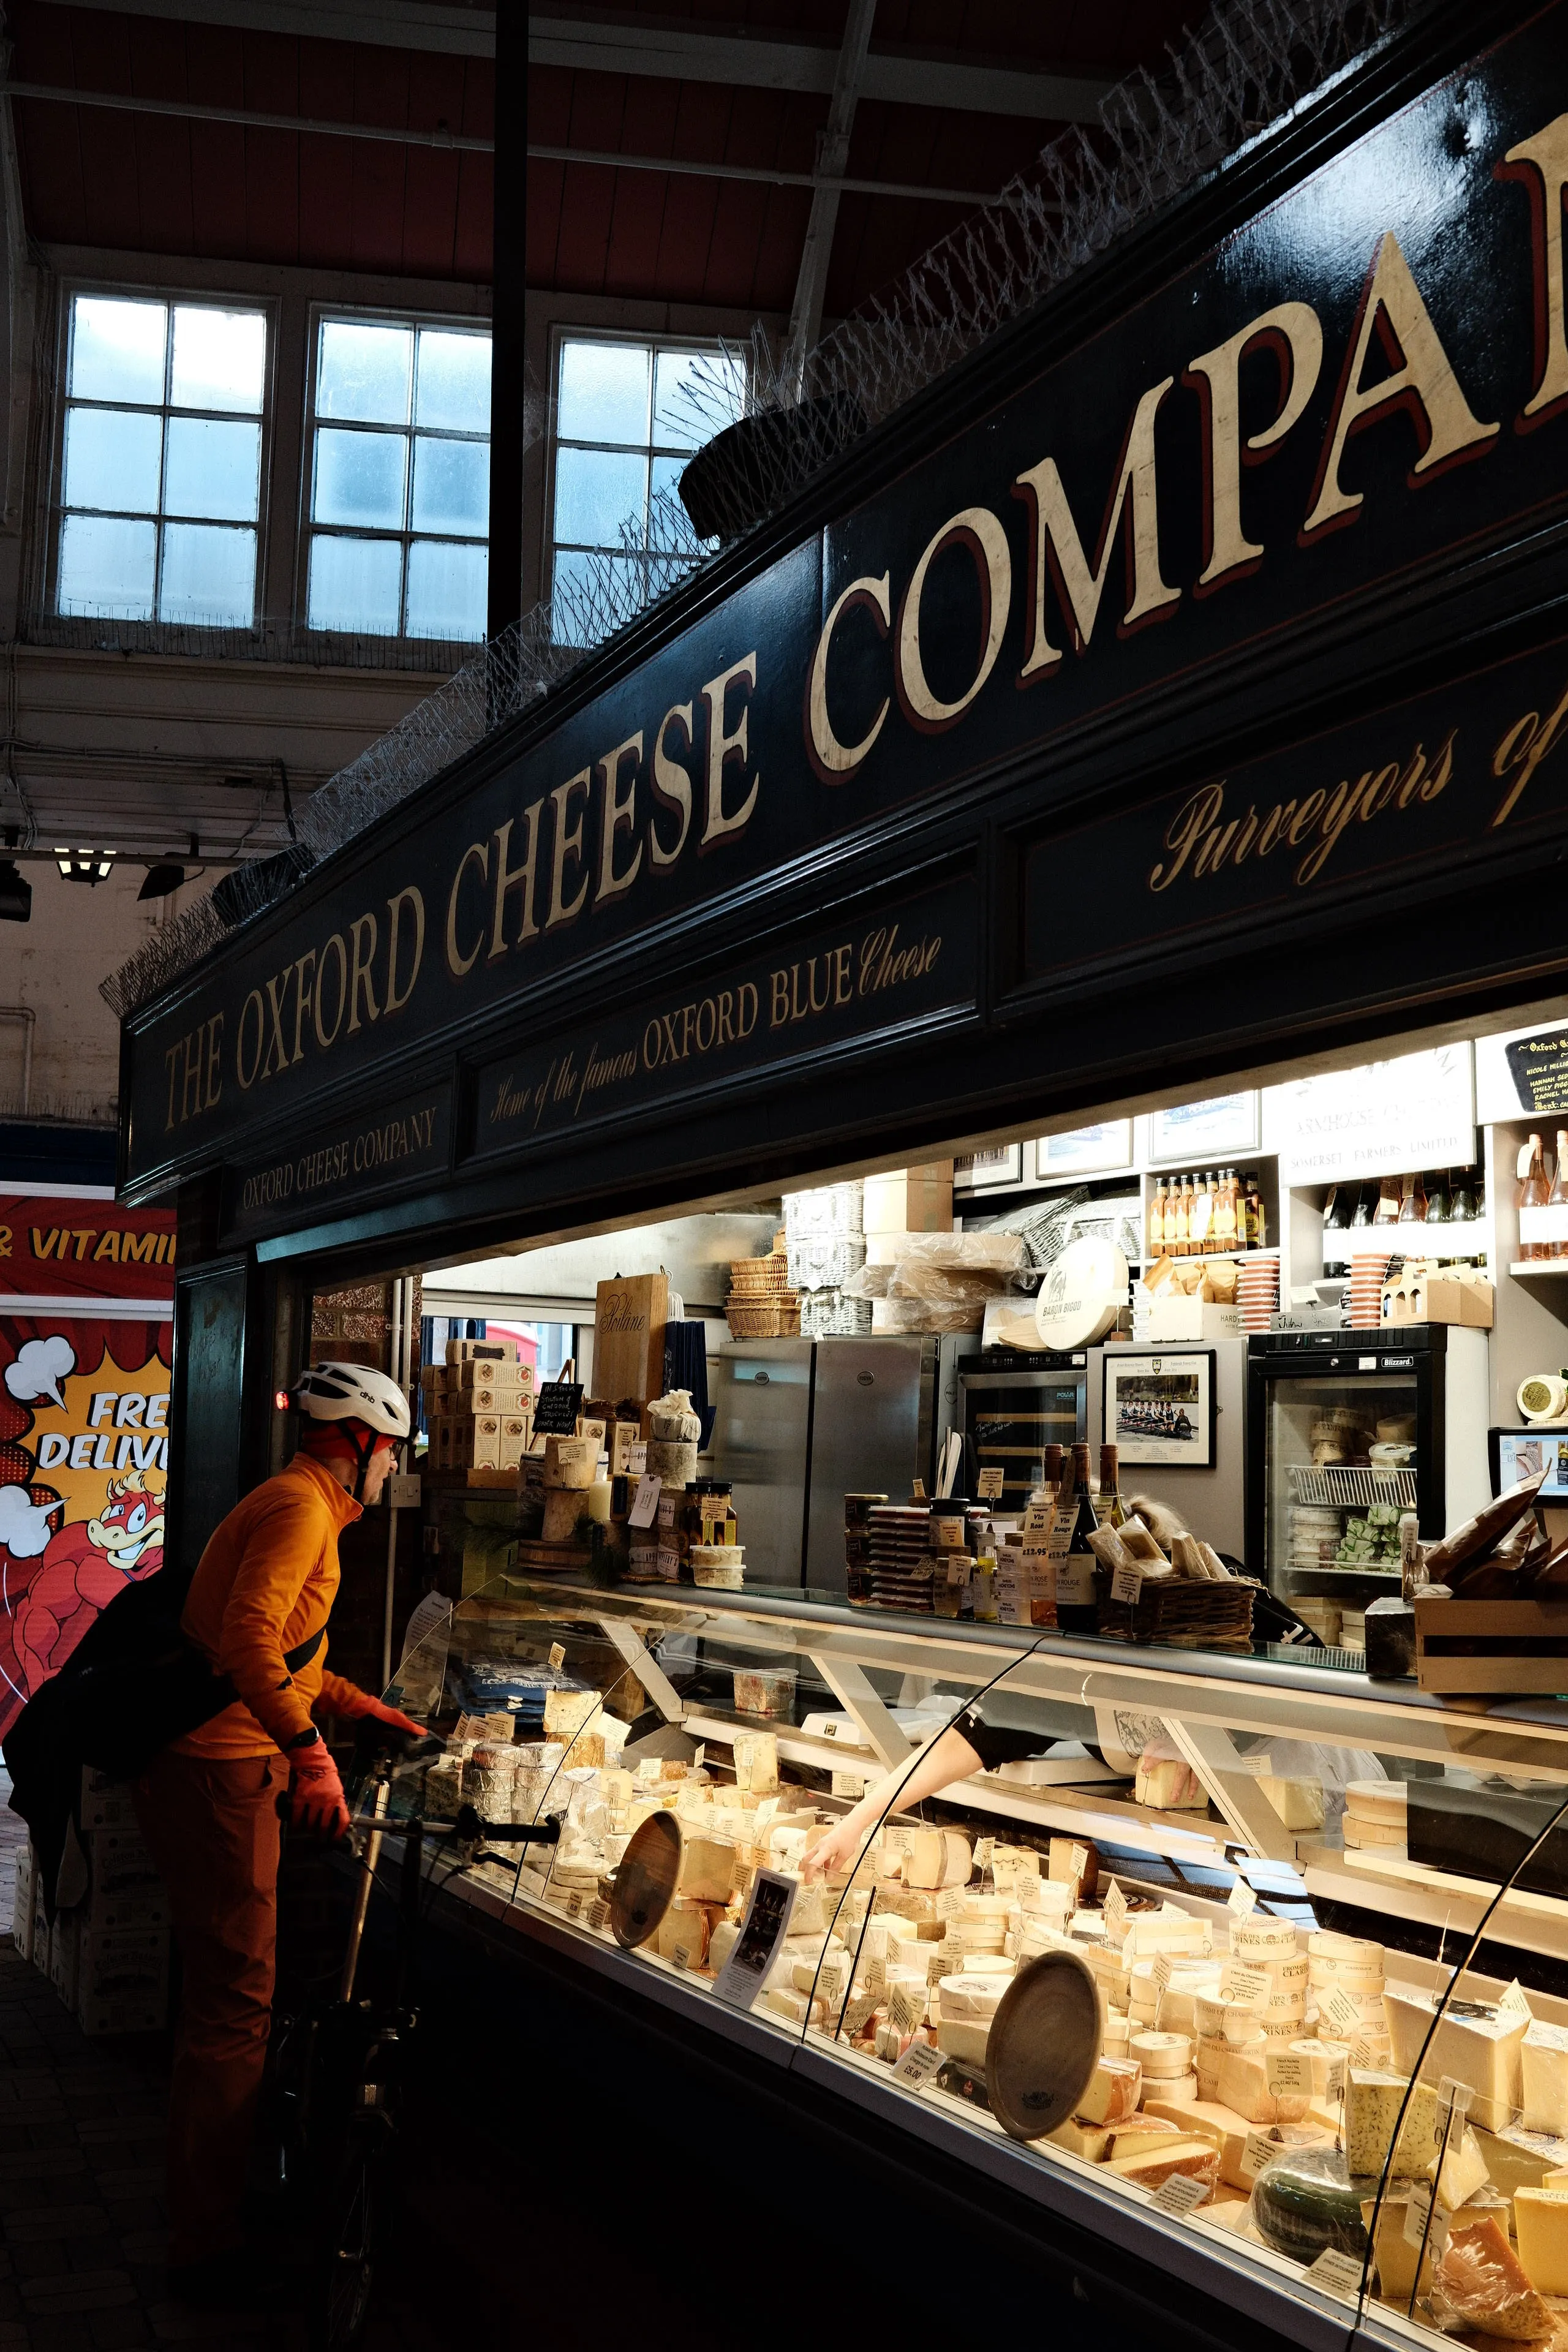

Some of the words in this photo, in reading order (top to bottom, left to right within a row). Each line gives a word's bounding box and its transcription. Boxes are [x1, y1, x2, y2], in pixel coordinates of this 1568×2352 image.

[1149, 728, 1459, 892] Purveyors
[165, 1011, 225, 1132] THE
[236, 886, 426, 1090] OXFORD
[447, 650, 760, 976] CHEESE
[575, 1042, 639, 1117] famous
[643, 982, 759, 1069] OXFORD
[770, 943, 853, 1028] BLUE
[858, 923, 942, 998] Cheese
[243, 1163, 293, 1210] OXFORD
[296, 1140, 350, 1192] CHEESE
[353, 1106, 437, 1172] COMPANY
[1291, 1152, 1342, 1169] SOMERSET
[1042, 1304, 1063, 1317] BARON
[903, 2065, 922, 2079] £5.00
